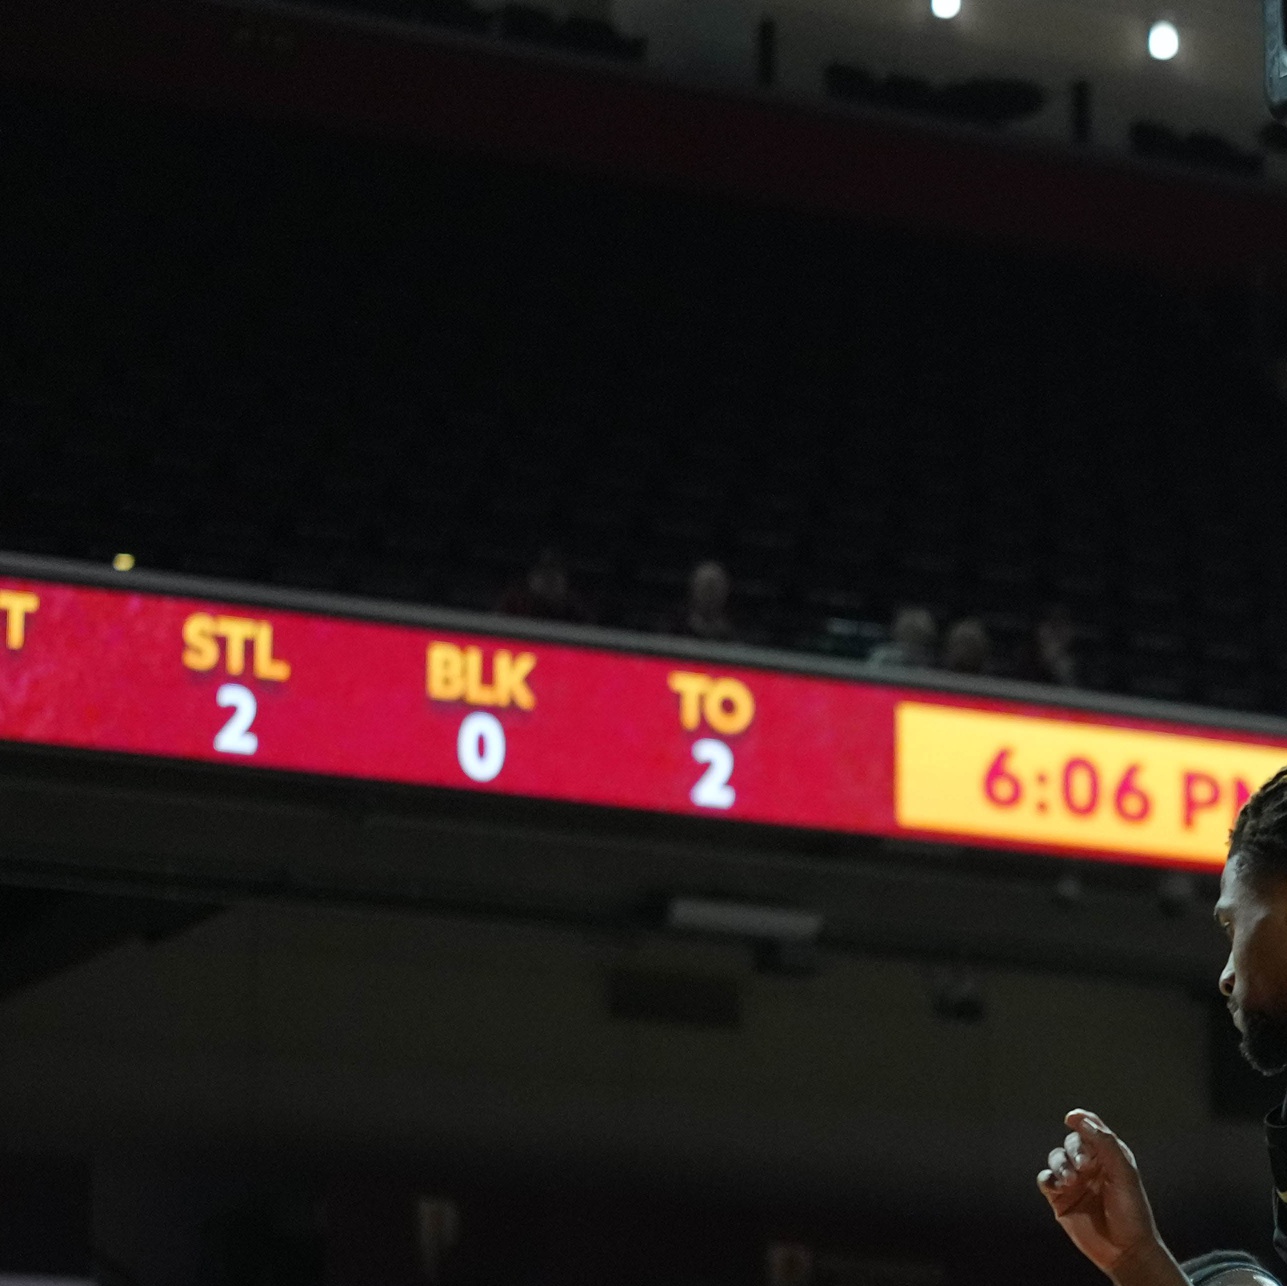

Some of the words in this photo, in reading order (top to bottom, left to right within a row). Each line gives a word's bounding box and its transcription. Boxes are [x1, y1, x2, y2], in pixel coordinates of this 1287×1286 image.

[182, 614, 291, 682] STL
[427, 641, 537, 710] BLK
[668, 670, 756, 736] TO
[213, 683, 259, 755] 2
[457, 711, 507, 782] 0
[690, 737, 737, 809] 2
[981, 746, 1152, 825] 6:06
